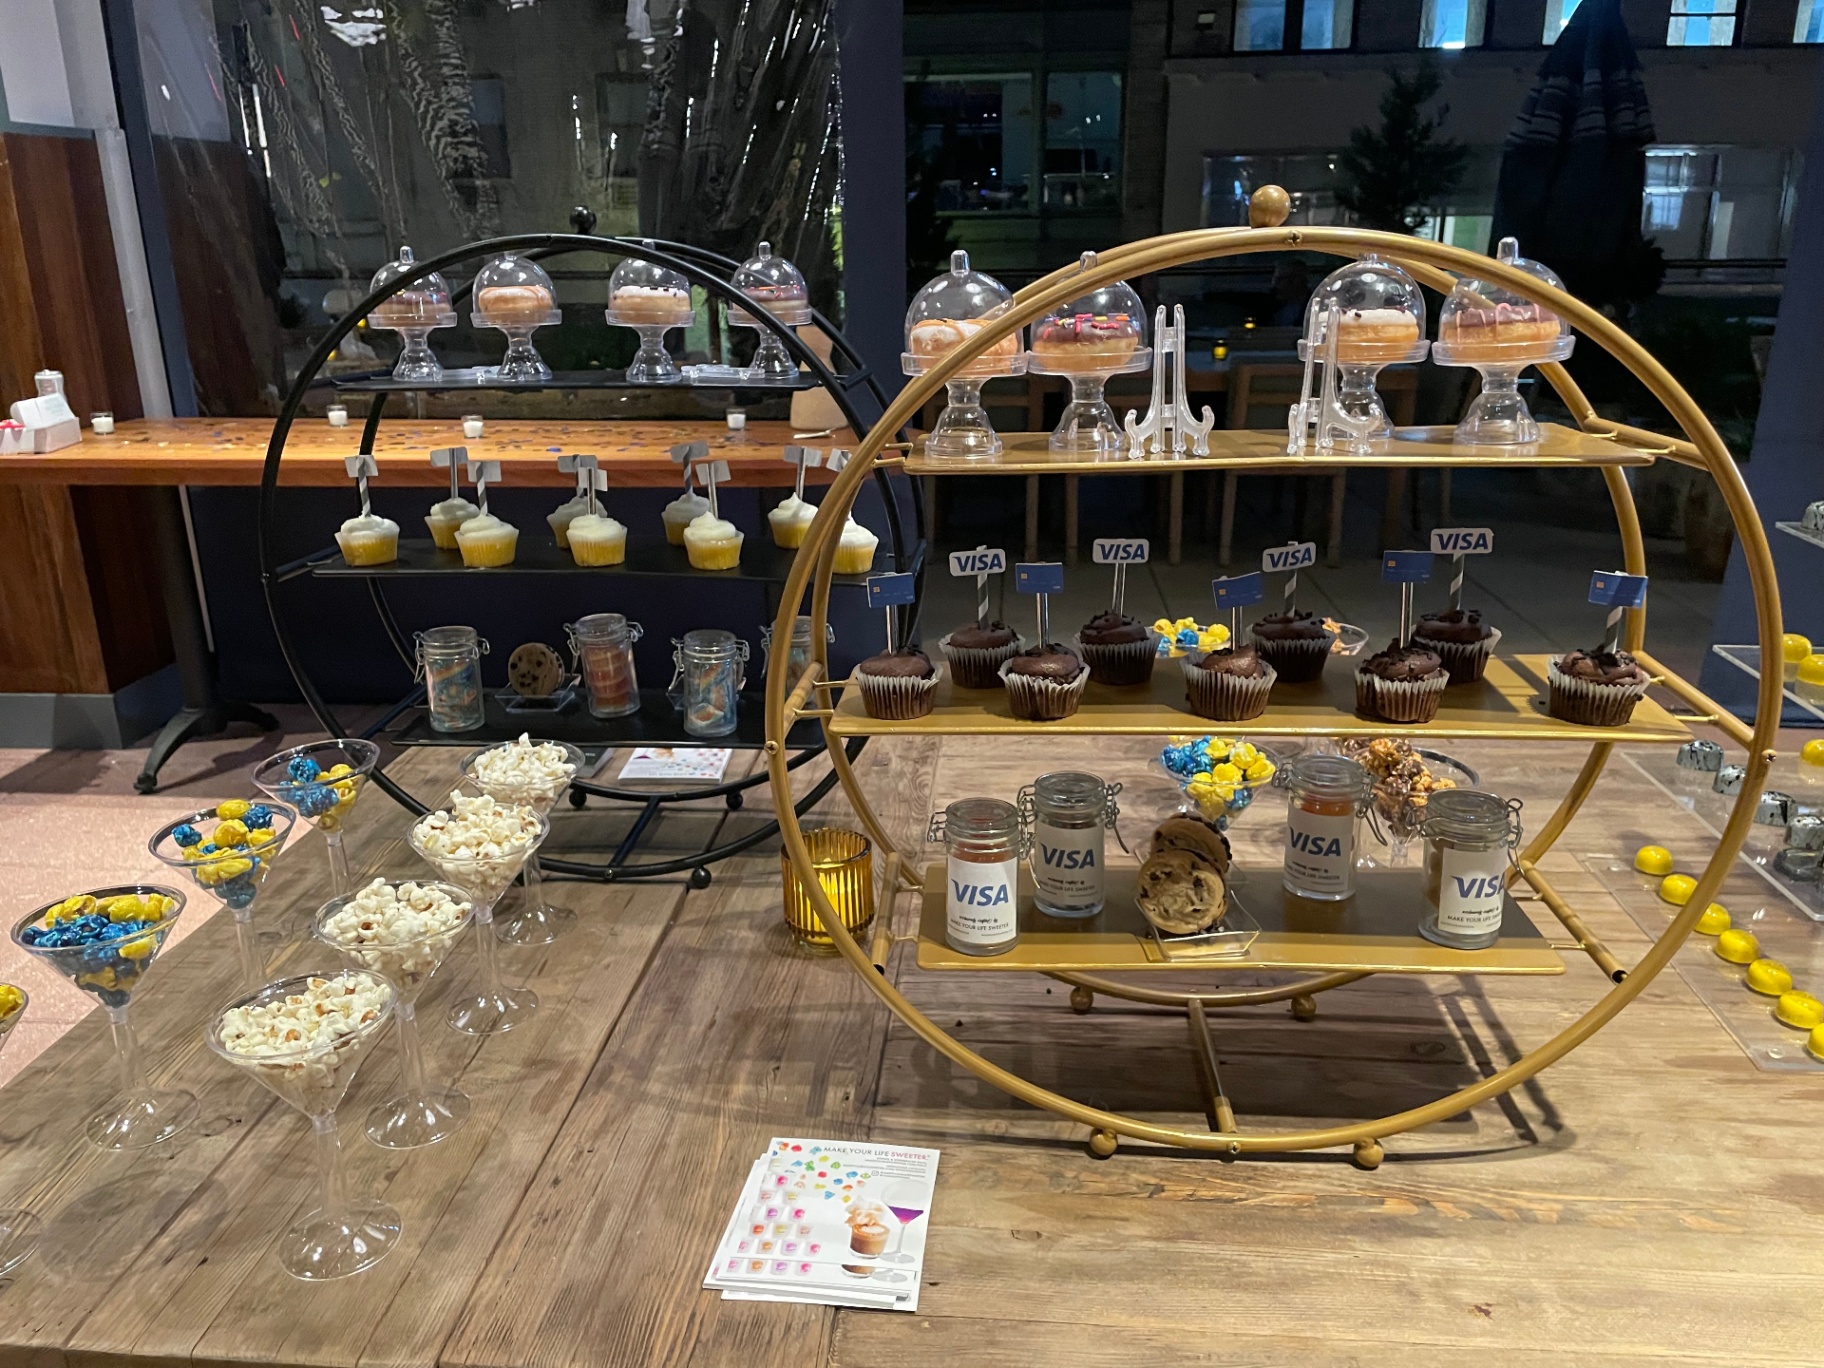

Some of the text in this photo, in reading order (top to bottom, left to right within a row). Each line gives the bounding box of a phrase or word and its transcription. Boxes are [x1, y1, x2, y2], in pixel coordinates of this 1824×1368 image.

[1433, 532, 1489, 550] VISA
[1097, 543, 1146, 560] VISA
[1266, 547, 1312, 568] VISA
[952, 553, 1003, 572] VISA
[1289, 826, 1341, 857] VISA
[1040, 843, 1095, 869] VISA
[951, 878, 1009, 906] VISA
[823, 1146, 847, 1154] MAKE
